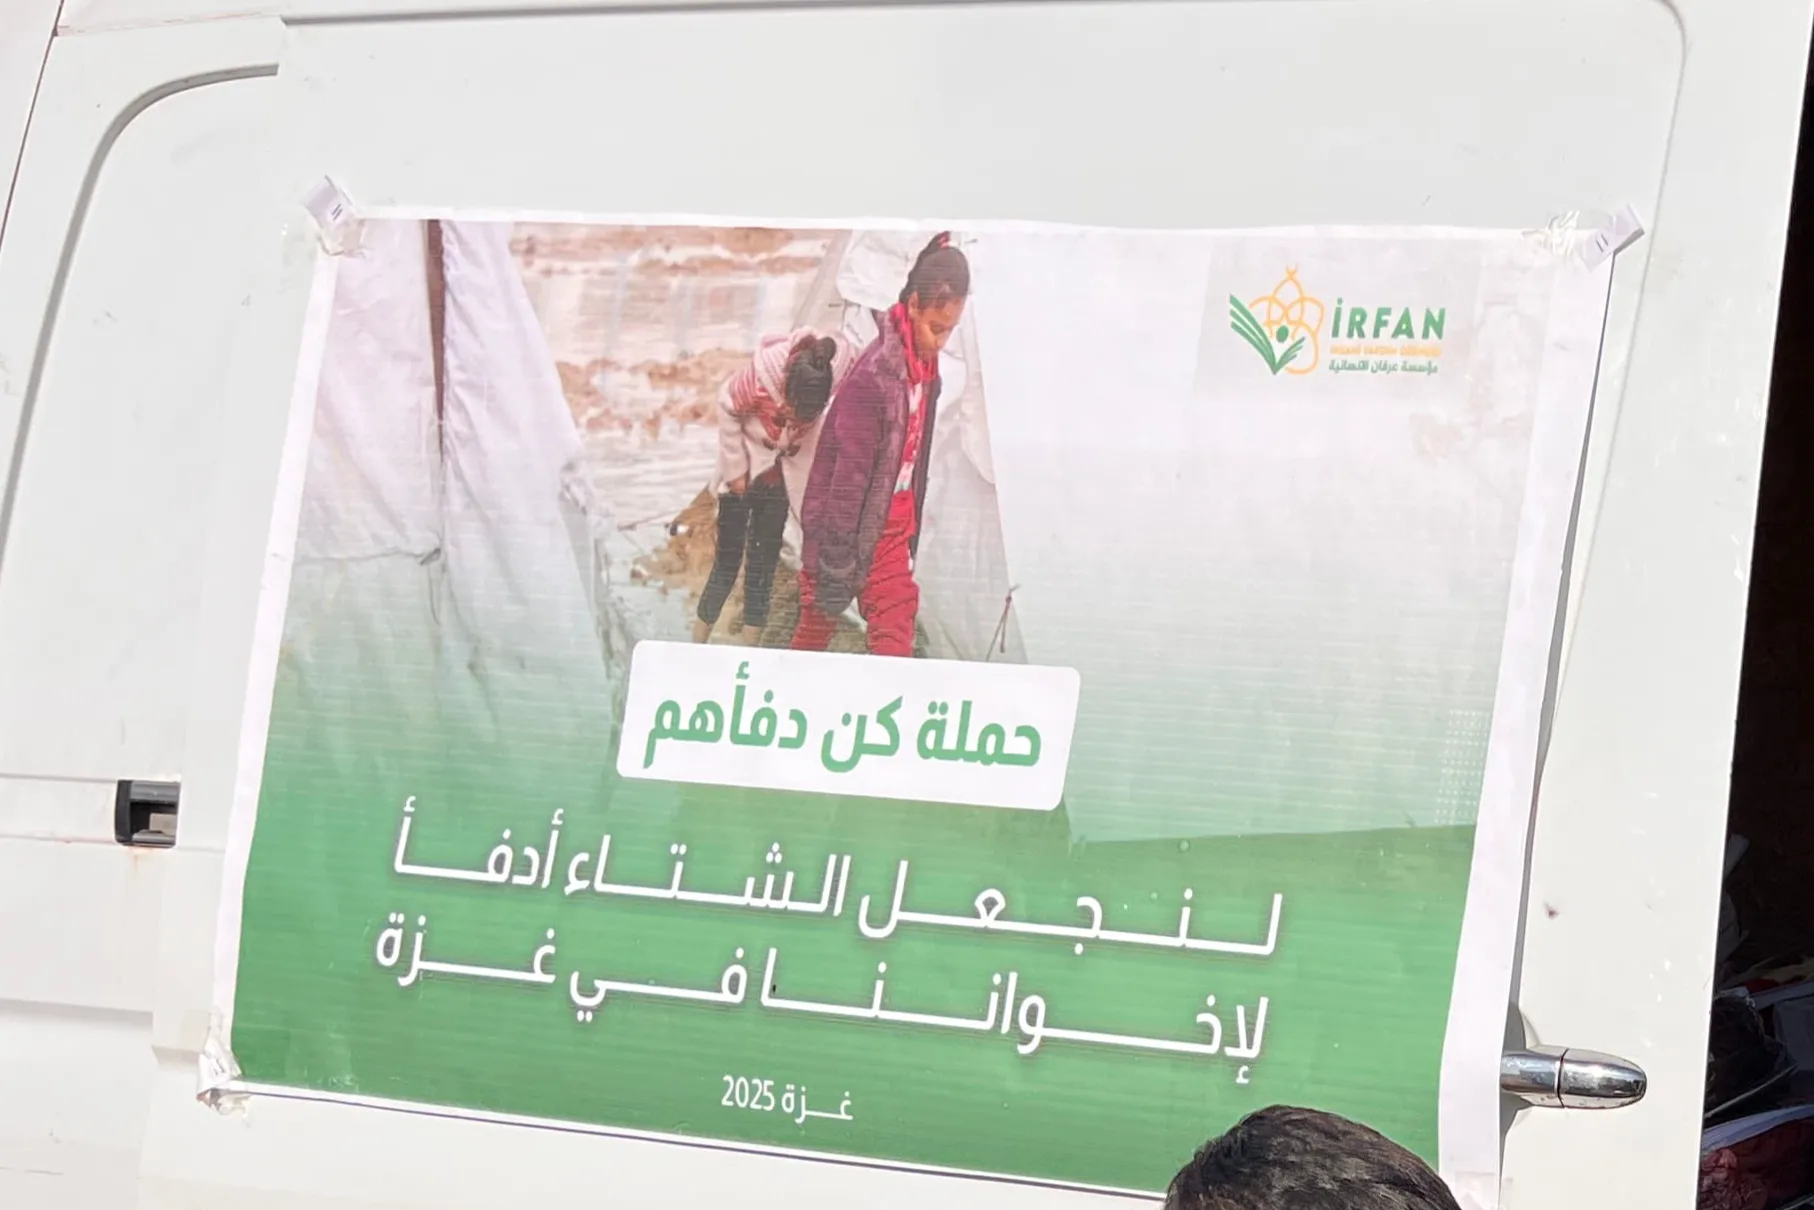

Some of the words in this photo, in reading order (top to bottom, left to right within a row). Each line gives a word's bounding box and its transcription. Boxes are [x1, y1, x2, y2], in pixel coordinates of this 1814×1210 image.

[1371, 359, 1399, 374] عرفان
[1401, 360, 1438, 376] مؤسسة
[643, 661, 808, 769] دفأهم
[820, 695, 903, 773] كن
[916, 700, 1041, 767] حملة
[394, 795, 564, 889] أدفأ
[564, 834, 851, 917] الشتاء
[376, 912, 556, 986] غزة
[570, 947, 748, 1022] في
[721, 1074, 776, 1111] 2025
[782, 1083, 854, 1124] غزة
